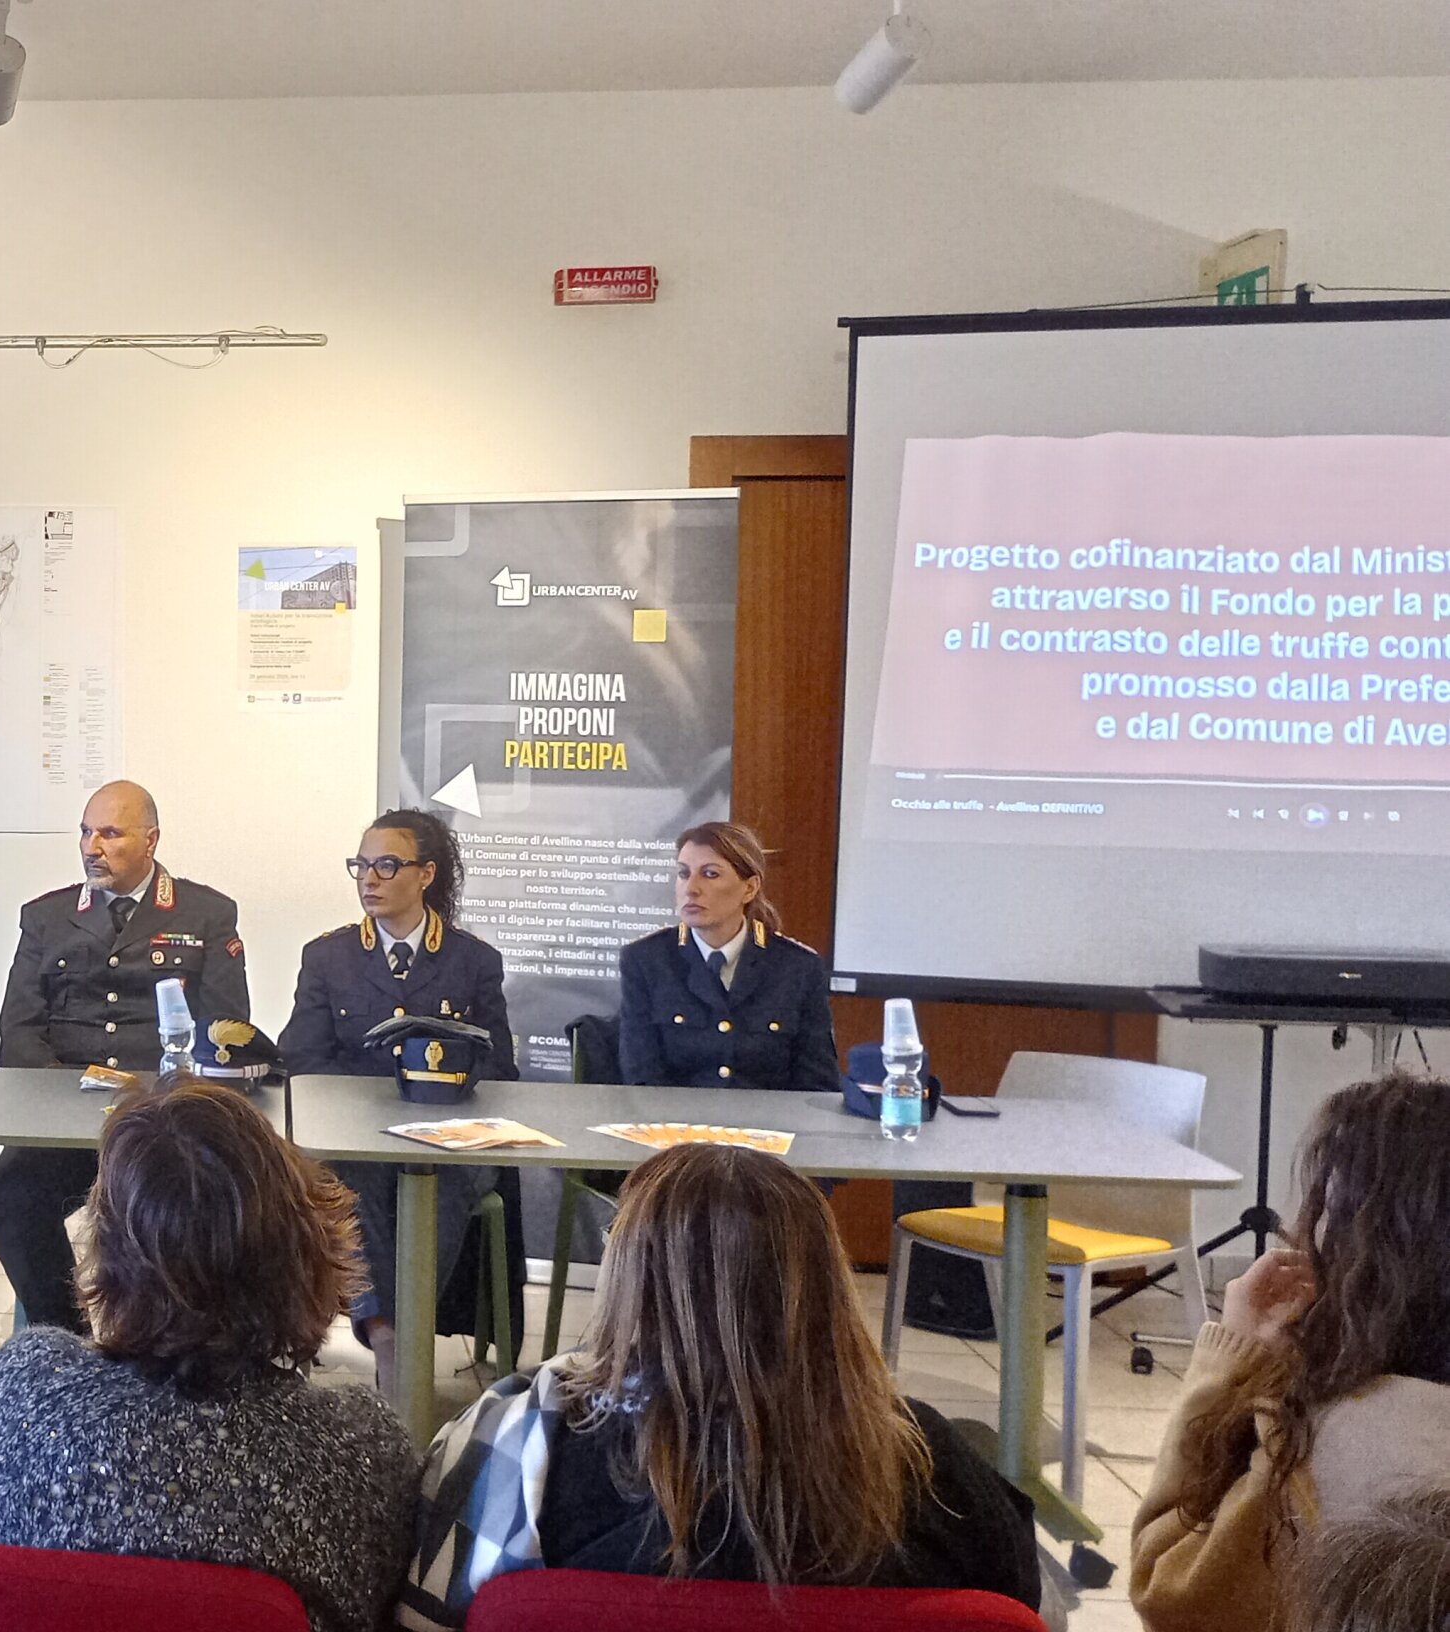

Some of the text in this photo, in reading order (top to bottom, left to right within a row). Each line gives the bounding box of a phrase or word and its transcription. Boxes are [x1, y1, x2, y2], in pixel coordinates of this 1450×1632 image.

[572, 269, 647, 283] ALLARME
[915, 538, 1450, 575] Progetto cofinanziato dal Minis
[291, 581, 318, 591] CENTER
[320, 581, 330, 591] AV
[532, 585, 638, 600] URBANCENTER AV
[991, 585, 1171, 611] attraverso
[1181, 583, 1200, 614] il
[1211, 587, 1316, 616] Fondo
[1326, 594, 1383, 622] per
[1393, 587, 1422, 615] la
[944, 628, 962, 649] e
[971, 621, 990, 649] il
[1000, 627, 1169, 654] contrasto
[1178, 629, 1261, 657] delle
[1270, 630, 1369, 659] truffe
[510, 673, 626, 702] IMMAGINA
[1081, 671, 1450, 702] promosso dalla Prefe
[518, 707, 615, 736] PROPONI
[1096, 715, 1116, 738] e
[1126, 712, 1180, 740] dal
[1189, 712, 1333, 744] Comune
[1344, 715, 1375, 744] di
[504, 740, 627, 770] PARTECIPA
[892, 798, 931, 810] Occhio
[933, 800, 951, 810] alle
[953, 800, 983, 811] truffe
[997, 801, 1039, 813] Avellino
[1042, 803, 1104, 815] DEFINITIVO
[458, 833, 676, 850] L'Urban Center di Avellino nasce dalla volont
[476, 850, 517, 860] Comune
[519, 851, 529, 860] di
[531, 854, 562, 862] creare
[580, 855, 609, 864] punto
[611, 855, 621, 864] di
[468, 866, 669, 883] strategico per lo sviluppo sostenibile del
[526, 885, 607, 896] nostro territorio.
[488, 899, 507, 908] una
[509, 899, 567, 910] piattaforma
[569, 901, 616, 913] dinamica
[617, 904, 637, 914] che
[639, 905, 673, 915] unisce
[491, 915, 497, 923] e
[499, 914, 505, 923] il
[507, 915, 545, 926] digitale
[547, 918, 564, 927] per
[566, 917, 610, 928] facilitare
[554, 949, 595, 960] cittadini
[607, 952, 615, 961] le
[543, 964, 553, 973] le
[555, 965, 595, 976] imprese
[607, 968, 615, 977] le
